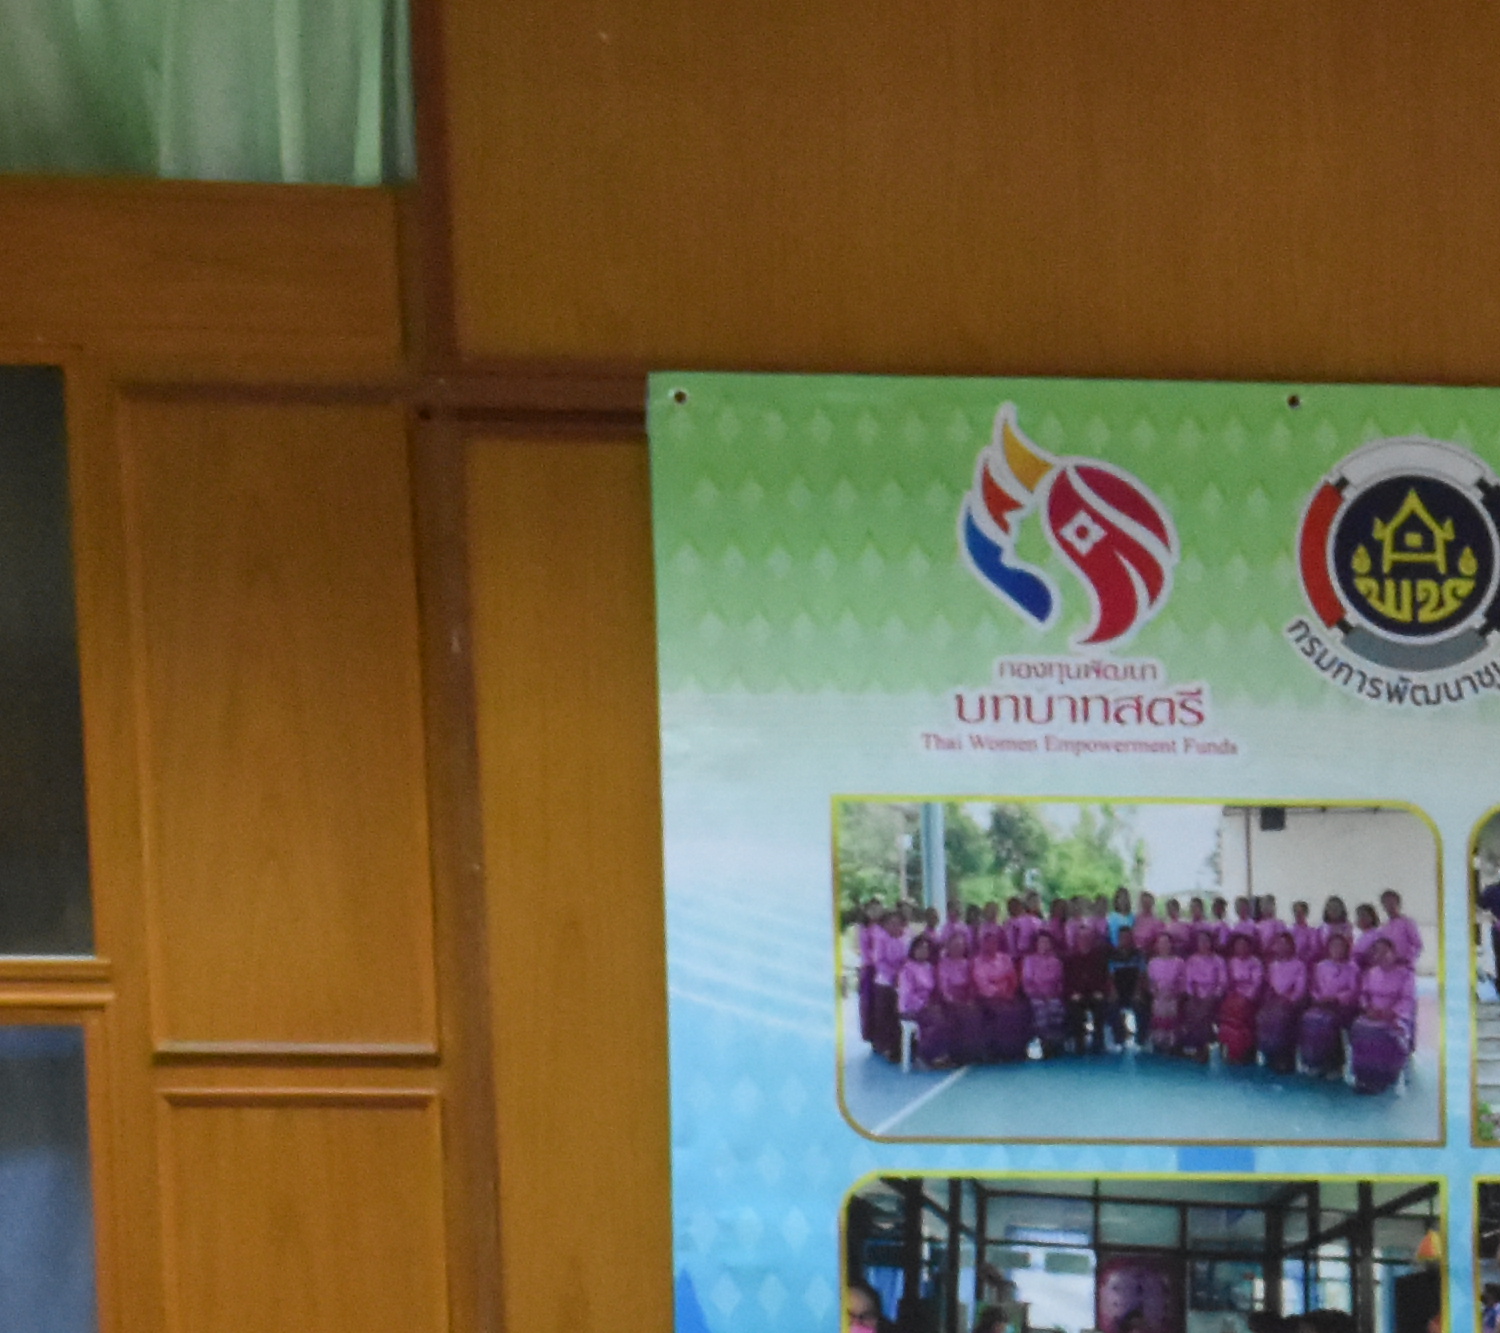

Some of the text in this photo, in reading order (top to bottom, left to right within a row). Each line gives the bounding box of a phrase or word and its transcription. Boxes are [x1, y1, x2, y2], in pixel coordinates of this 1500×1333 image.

[999, 659, 1158, 685] กองทุนพัฒนา
[955, 687, 1205, 727] บทบาทสตรี
[921, 732, 1238, 756] Thai Women Empowerment Funds
